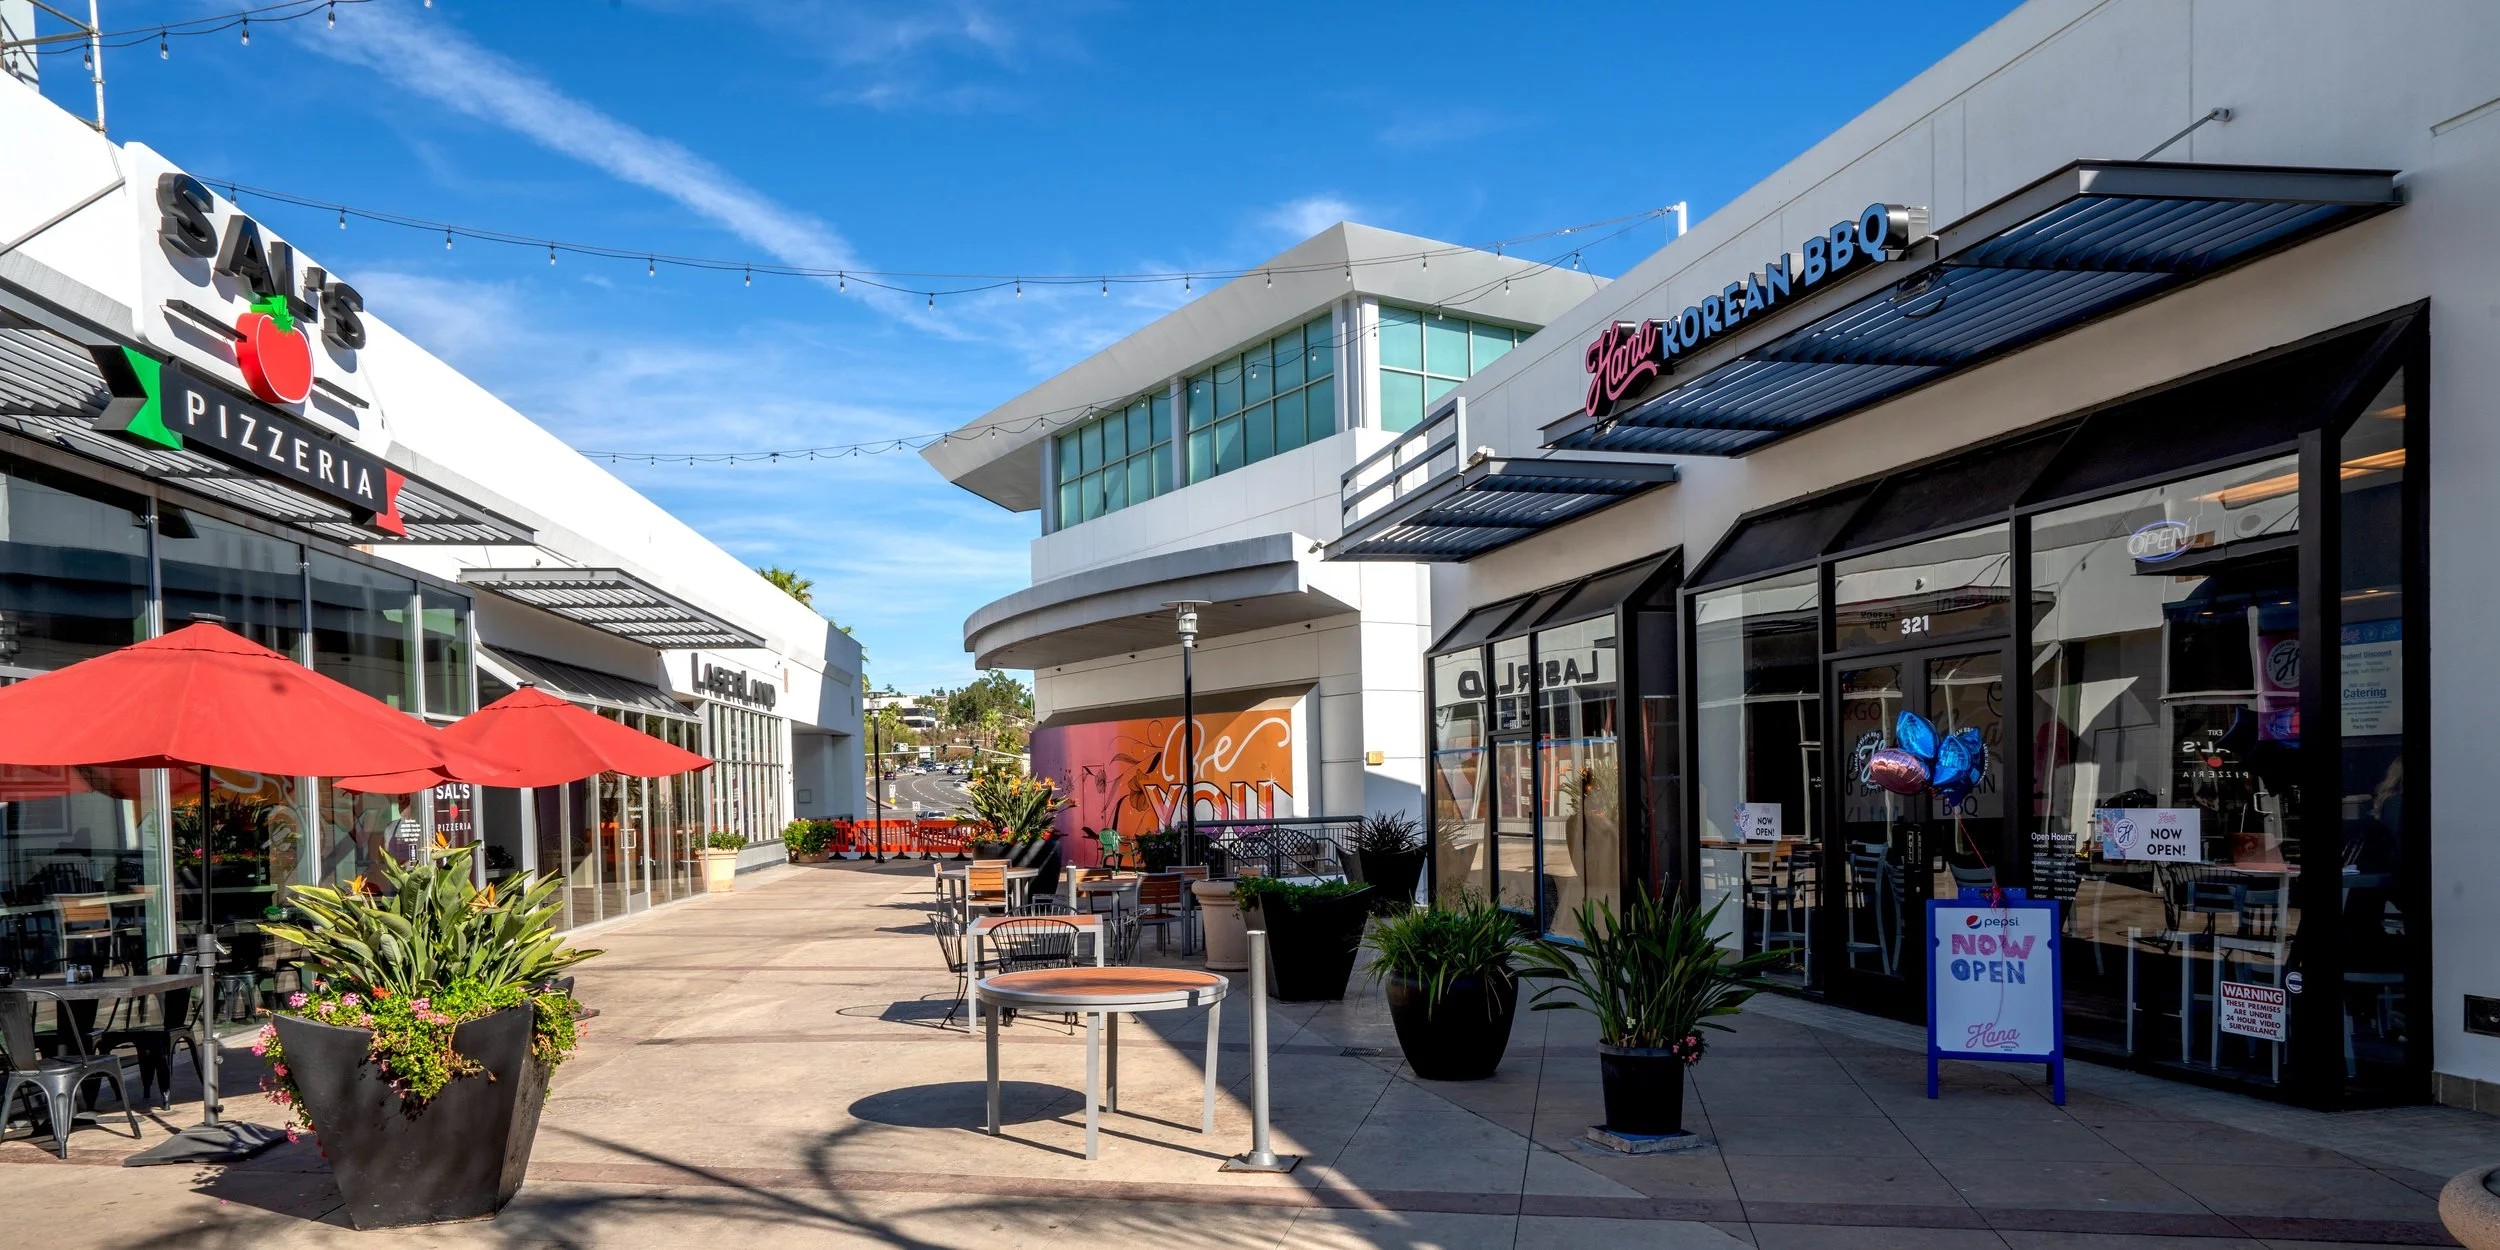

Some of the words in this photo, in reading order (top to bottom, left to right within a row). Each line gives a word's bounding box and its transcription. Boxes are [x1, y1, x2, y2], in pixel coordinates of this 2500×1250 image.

[156, 172, 366, 351] SAL'S
[1584, 318, 1658, 418] Hana
[1662, 252, 1791, 360] KOREAN
[1802, 202, 1889, 287] BBQ
[186, 389, 374, 500] PIZZERIA
[2129, 517, 2191, 555] OPEN
[1901, 614, 1929, 635] 321
[2343, 688, 2387, 699] Catering
[1161, 717, 1291, 783] Be
[436, 783, 471, 800] SAL'S
[1144, 780, 1284, 836] YOU
[437, 822, 472, 832] PIZZERIA
[1757, 817, 1773, 825] NOW
[1755, 827, 1775, 837] OPEN!
[2031, 832, 2050, 842] Open
[2051, 832, 2075, 841] Hours:
[2150, 828, 2182, 840] NOW
[2147, 844, 2186, 856] OPEN!
[1984, 917, 2018, 929] pepsi
[1951, 934, 2036, 960] NOW
[1950, 958, 2025, 984] OPEN
[2223, 984, 2283, 1004] WARNING
[2248, 1003, 2281, 1013] PREMISES
[2249, 1011, 2272, 1020] UNDER
[2229, 1023, 2277, 1036] SURVEILLANCE
[2237, 1016, 2256, 1025] HOUR
[2260, 1020, 2281, 1029] VIDEO
[1965, 1022, 2020, 1049] Hana
